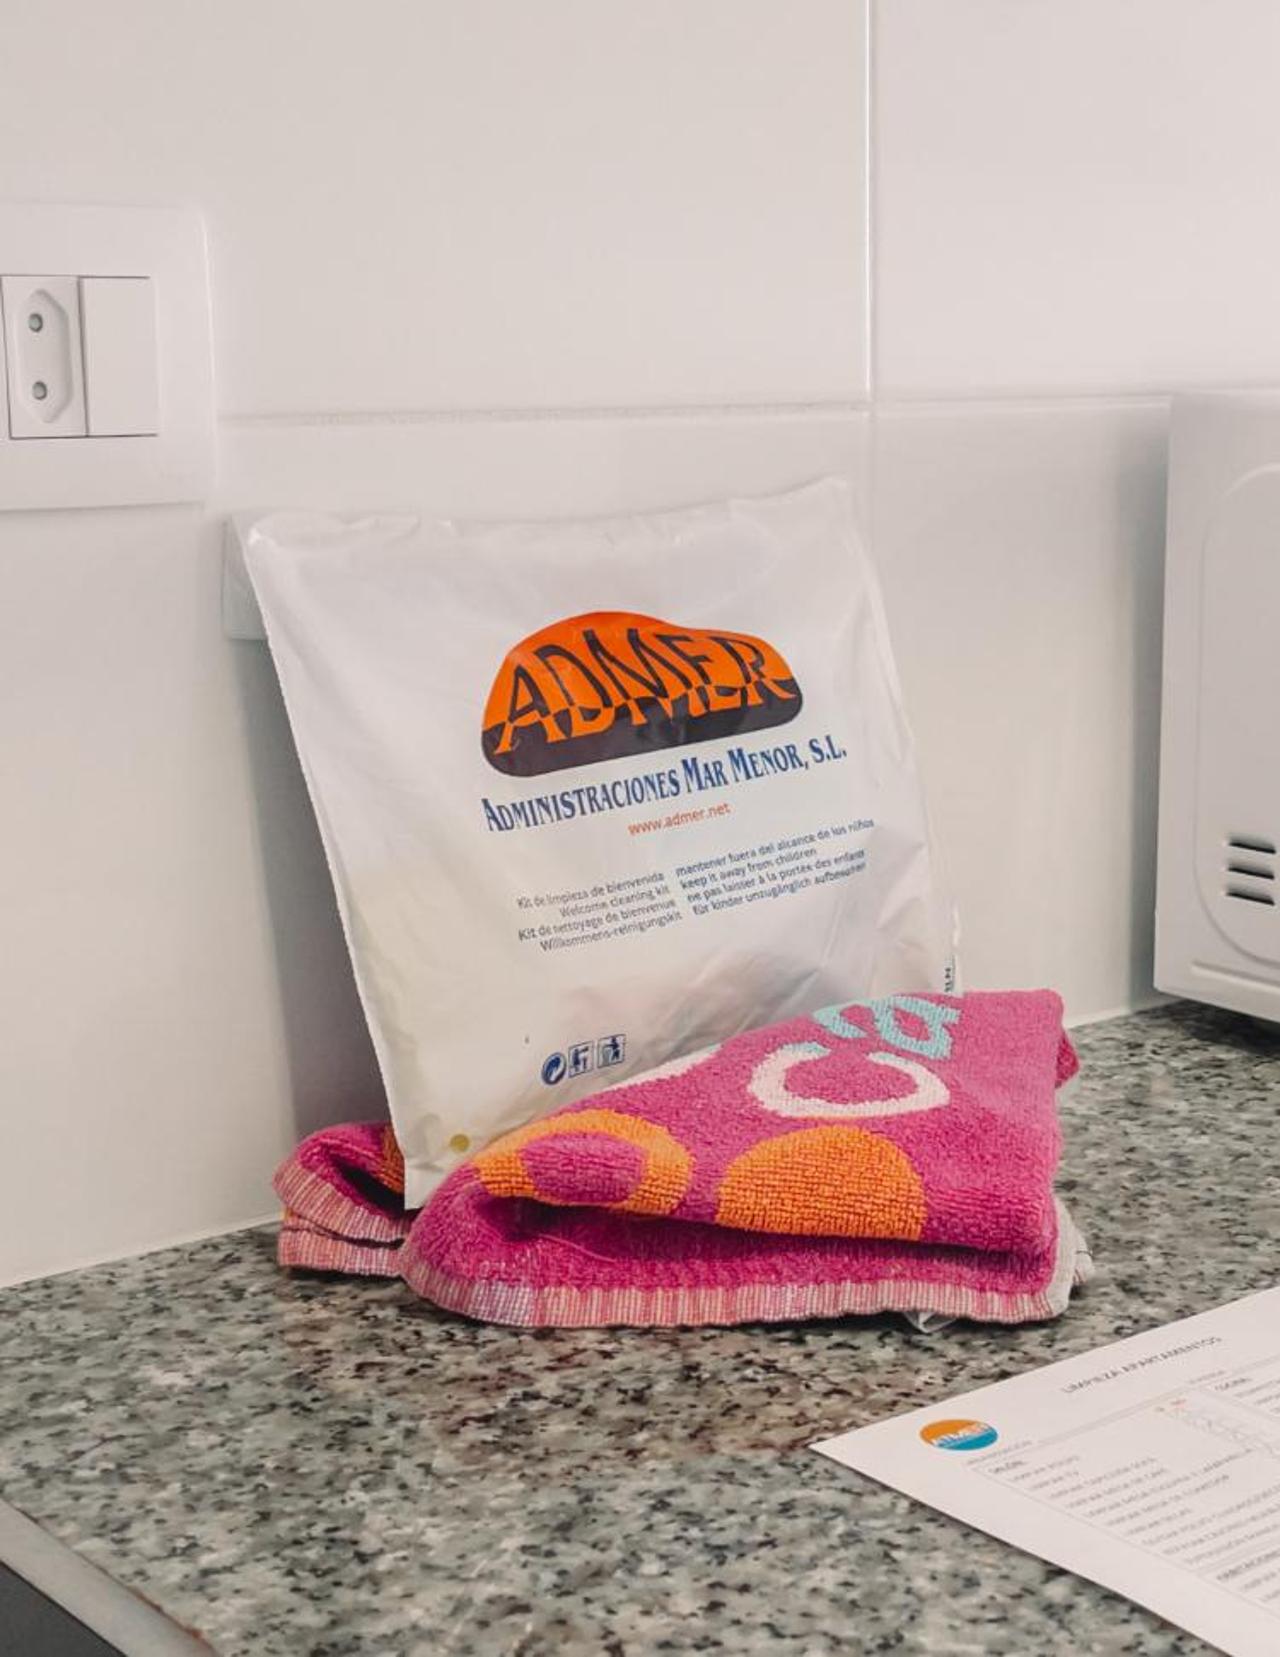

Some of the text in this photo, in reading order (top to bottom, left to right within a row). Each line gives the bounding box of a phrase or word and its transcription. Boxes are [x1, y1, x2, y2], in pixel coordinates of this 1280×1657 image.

[493, 627, 800, 755] ADMER
[810, 734, 848, 764] S.L.
[627, 802, 731, 836] www.admer.net
[675, 855, 727, 878] mantener
[728, 848, 757, 865] fuera
[758, 842, 775, 857] del
[776, 833, 816, 851] alcance
[817, 829, 831, 841] de
[680, 848, 817, 890] keep it away from children
[533, 895, 545, 907] de
[590, 885, 605, 898] de
[605, 871, 665, 894] bienvenida
[687, 892, 701, 903] ne
[704, 886, 722, 901] pas
[722, 877, 756, 893] laisser
[758, 874, 766, 885] à
[766, 870, 777, 882] la
[815, 858, 832, 870] des
[559, 883, 671, 918] Welcome cleaning kit
[711, 894, 744, 910] kinder
[517, 928, 538, 942] Kit
[538, 924, 553, 937] de
[553, 915, 604, 936] nettoyage
[605, 911, 620, 924] de
